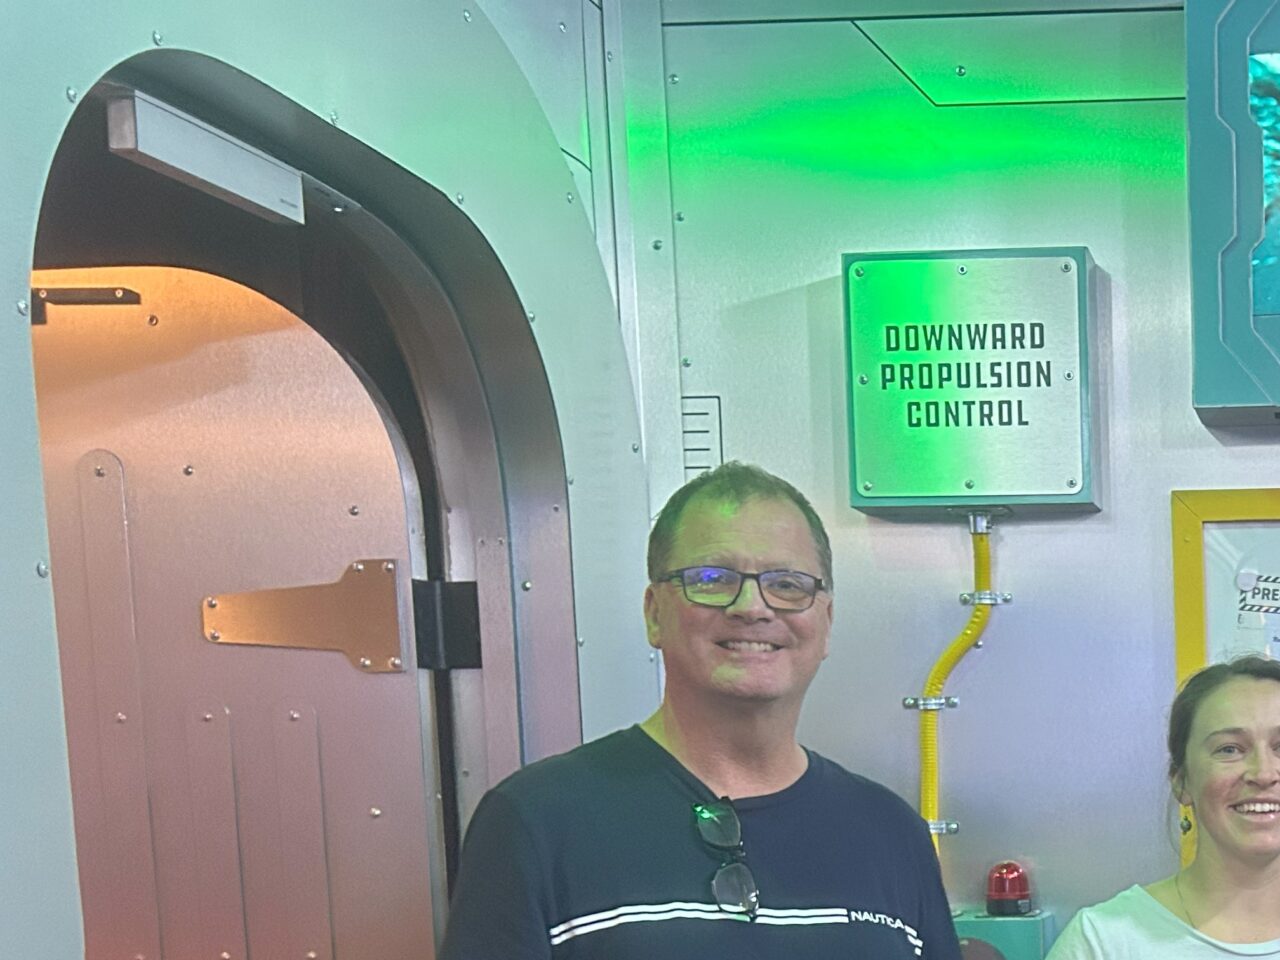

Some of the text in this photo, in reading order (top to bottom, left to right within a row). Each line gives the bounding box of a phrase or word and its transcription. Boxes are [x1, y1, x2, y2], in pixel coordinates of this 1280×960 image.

[885, 322, 1045, 351] DOWNWARD
[881, 361, 1052, 390] PROPULSION
[907, 400, 1029, 427] CONTROL
[850, 910, 905, 930] NAUTICA
